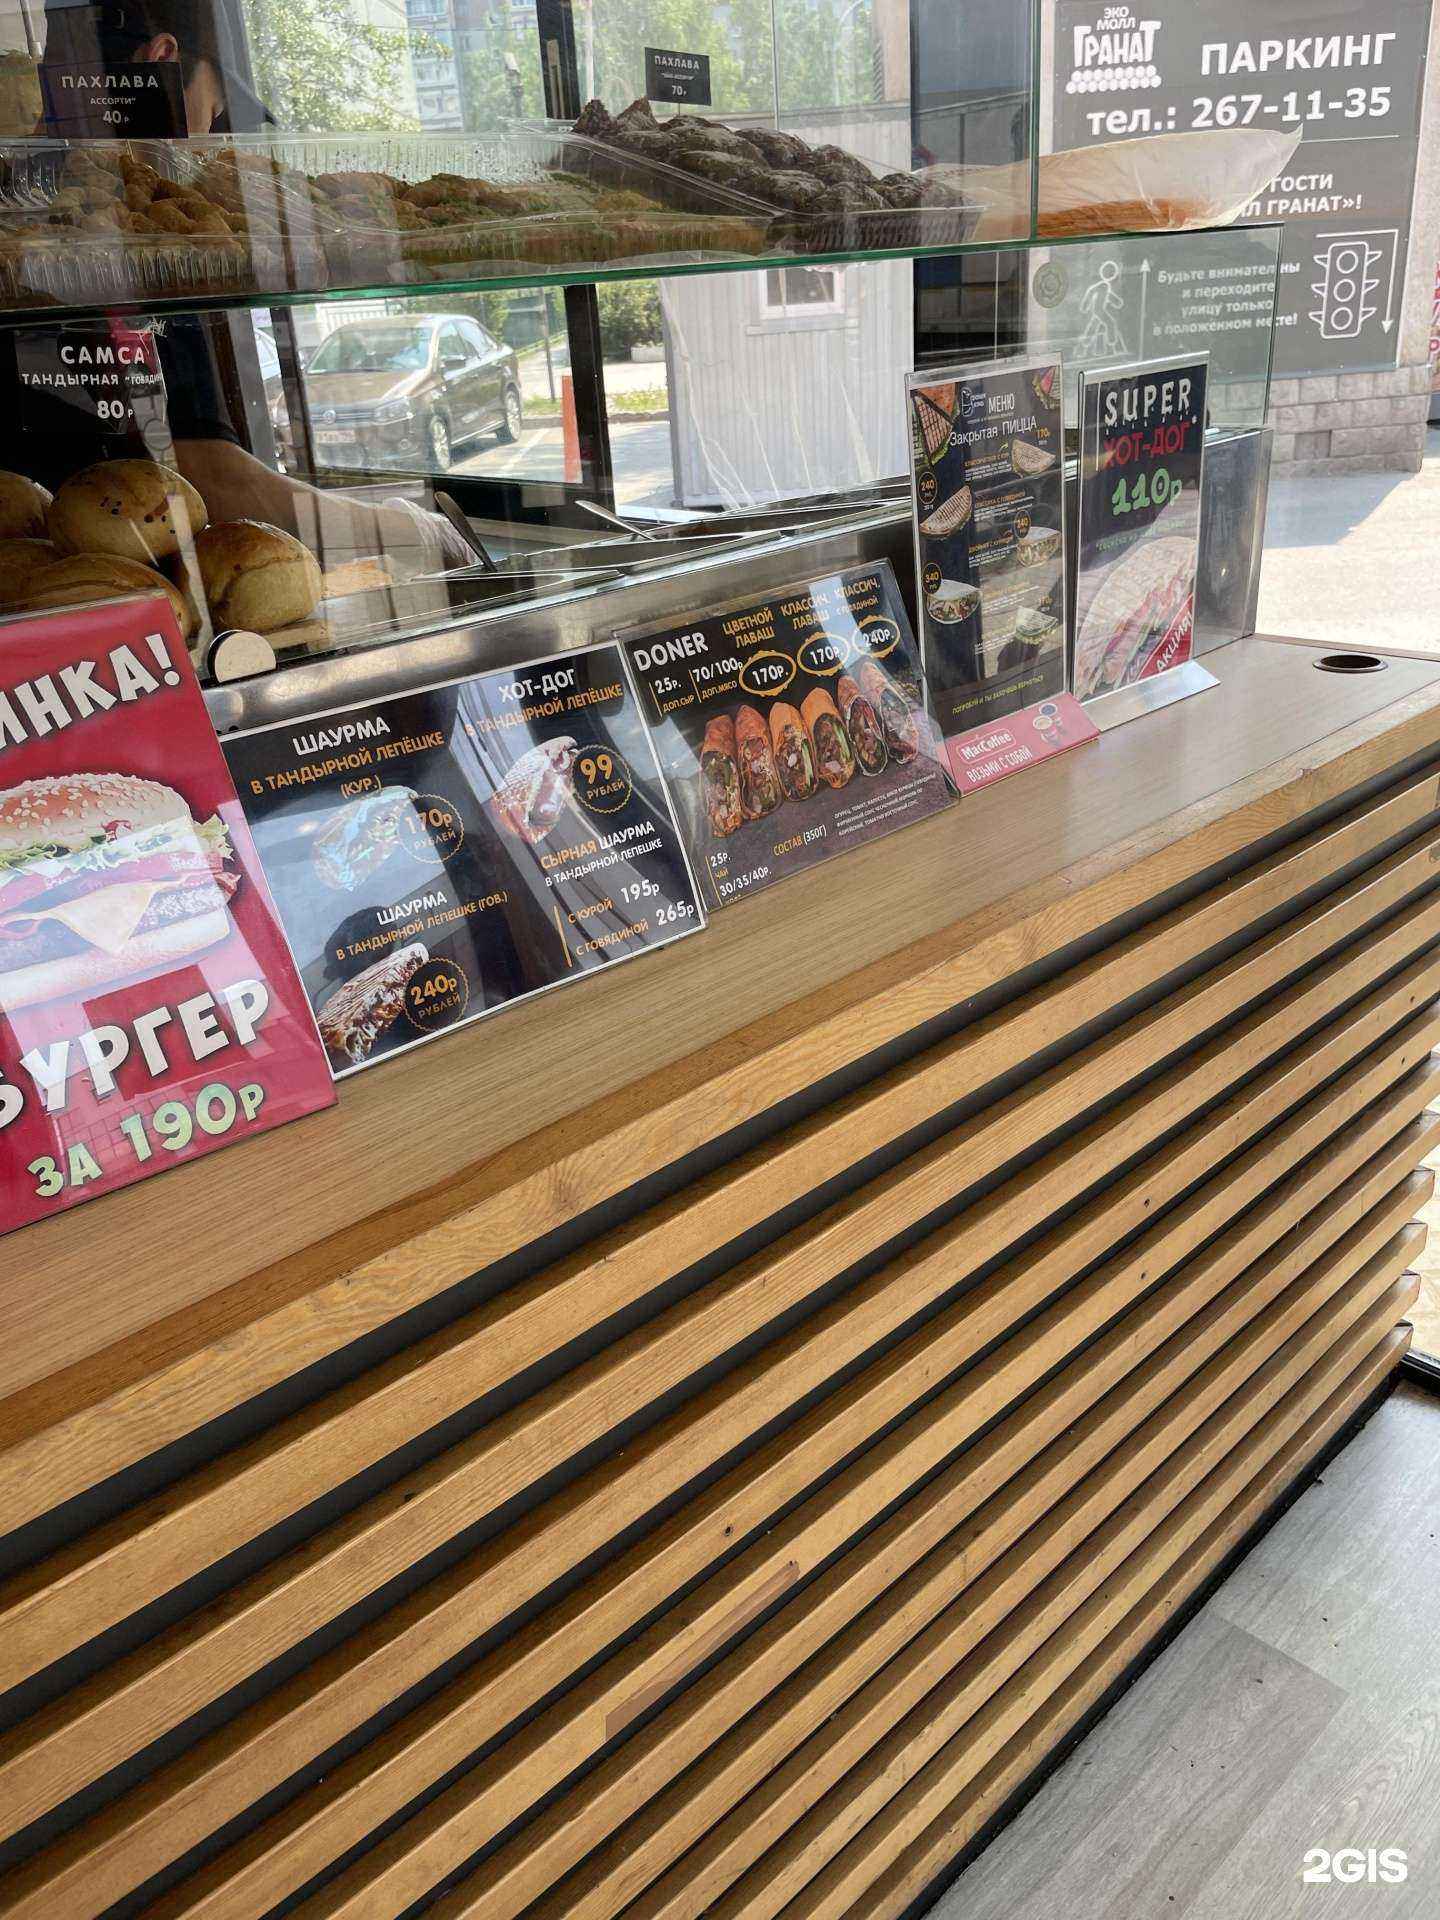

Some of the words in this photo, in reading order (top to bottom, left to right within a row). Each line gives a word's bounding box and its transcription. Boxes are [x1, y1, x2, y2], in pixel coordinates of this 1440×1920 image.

[1096, 17, 1136, 31] МОЛЛ
[1103, 6, 1130, 19] ЭКО
[1073, 20, 1162, 68] ГРАНАТ
[1200, 32, 1397, 76] ПАРКИНГ
[655, 55, 700, 70] ПАХЛАВА
[61, 75, 159, 88] ПАХЛАВА
[1086, 107, 1177, 136] тел.:
[1190, 86, 1392, 129] 267-11-35
[1270, 174, 1333, 193] ГОСТИ
[1266, 194, 1362, 216] ГРАНАТ»!
[1157, 270, 1206, 285] Будьте
[1208, 262, 1301, 280] внимателны
[1181, 289, 1191, 299] и
[1194, 281, 1276, 299] переходите
[1181, 303, 1223, 318] улицу
[1225, 299, 1274, 313] только
[1164, 319, 1251, 335] положенном
[60, 345, 145, 365] САМСА
[21, 373, 119, 387] ТАНДЫРНАЯ
[989, 393, 1015, 413] МЕНЮ
[1104, 377, 1192, 429] SUPER
[950, 426, 998, 447] Закрытая
[1002, 416, 1037, 436] ПИЦЦА
[1103, 420, 1191, 469] ХОТ-ДОГ
[722, 606, 774, 636] ЦВЕТНОЙ
[792, 609, 831, 631] ЛАВАШ
[633, 631, 709, 672] DONER
[735, 626, 776, 649] ЛАВАШ
[498, 668, 575, 703] ХОТ-ДОГ
[476, 696, 565, 734] ТАНДЫРНОЙ
[566, 683, 624, 710] ЛЕПЁШКЕ
[292, 716, 391, 756] ШАУРМА
[960, 732, 1012, 760] MacCoffee
[250, 779, 264, 795] В
[265, 746, 373, 790] ТАНДЫРНОЙ
[376, 731, 445, 762] ЛЕПЁШКЕ
[580, 753, 614, 785] 99
[966, 761, 1001, 783] ВОЗЬМИ
[1007, 744, 1033, 767] СОБОЙ
[340, 774, 383, 799] (КУР.)
[586, 778, 625, 801] РУБЛЕЙ
[540, 839, 598, 870] СЫРНАЯ
[598, 820, 656, 851] ШАУРМА
[773, 835, 803, 857] СОСТАВ
[544, 876, 553, 887] В
[553, 851, 619, 884] ТАНДЫРНОЙ
[619, 838, 663, 862] ЛЕПЕШКЕ
[376, 890, 448, 926] ШАУРМА
[576, 897, 615, 920] КУРОЙ
[336, 948, 346, 961] В
[346, 918, 425, 956] ТАНДЫРНОЙ
[427, 902, 477, 929] ЛЕПЕШКЕ
[478, 891, 508, 912] (ГОВ.)
[584, 918, 649, 953] ГОВЯДИНОЙ
[416, 993, 461, 1019] РУБЛЕЙ
[26, 1142, 104, 1197] ЗА
